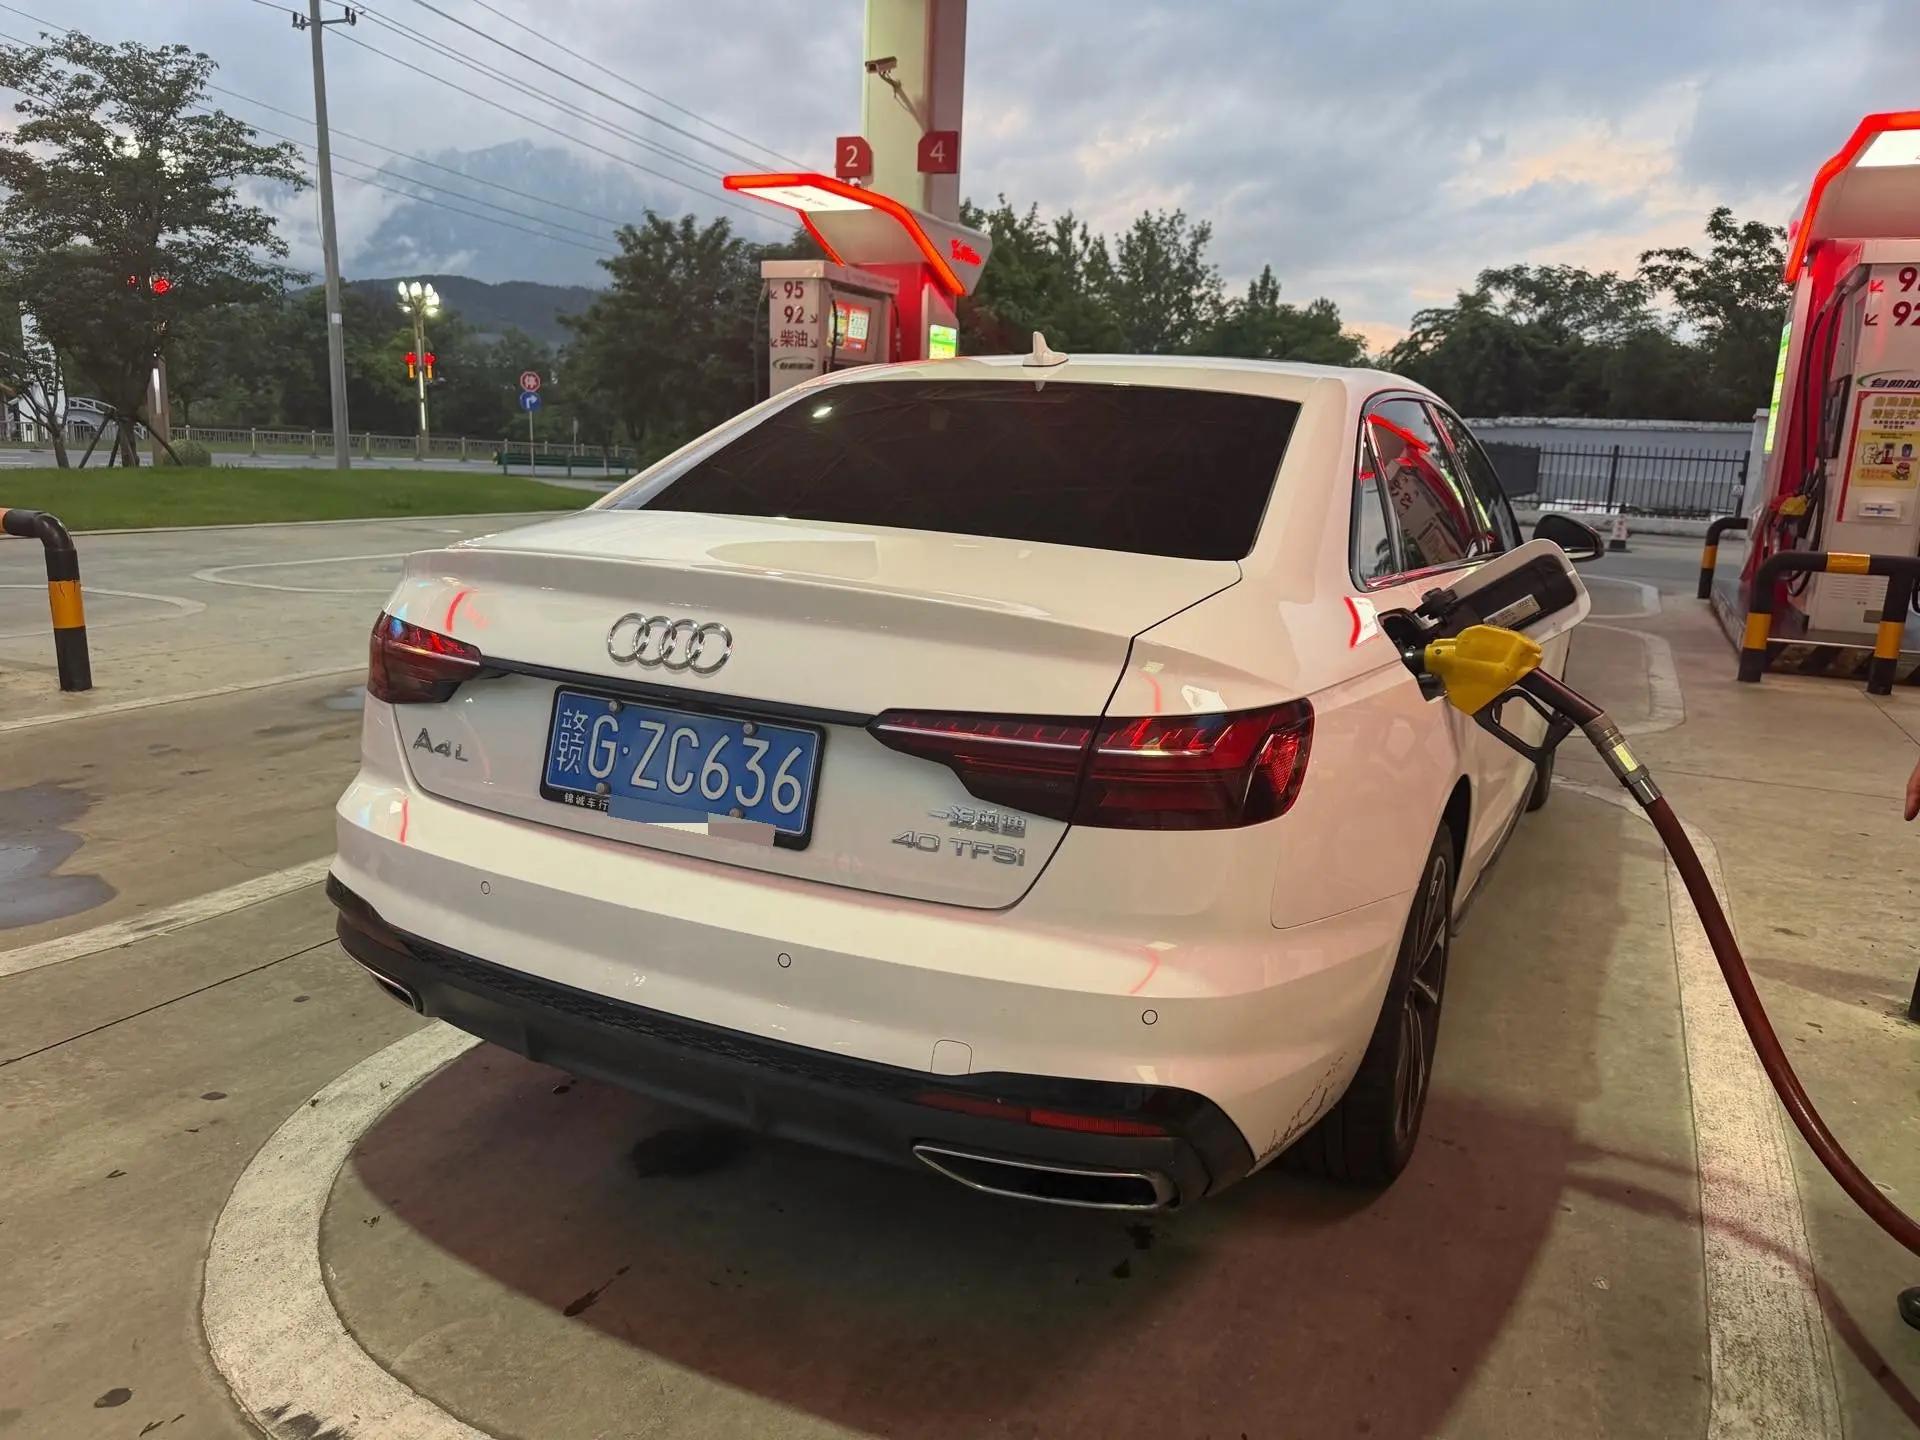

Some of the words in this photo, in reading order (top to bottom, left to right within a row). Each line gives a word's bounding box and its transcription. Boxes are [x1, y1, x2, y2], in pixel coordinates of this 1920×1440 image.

[845, 145, 858, 168] 2
[929, 140, 945, 163] 4
[783, 281, 804, 299] 95
[783, 305, 804, 324] 92
[780, 329, 808, 348] 柴油
[892, 830, 941, 853] 40
[949, 837, 1026, 867] TFSI
